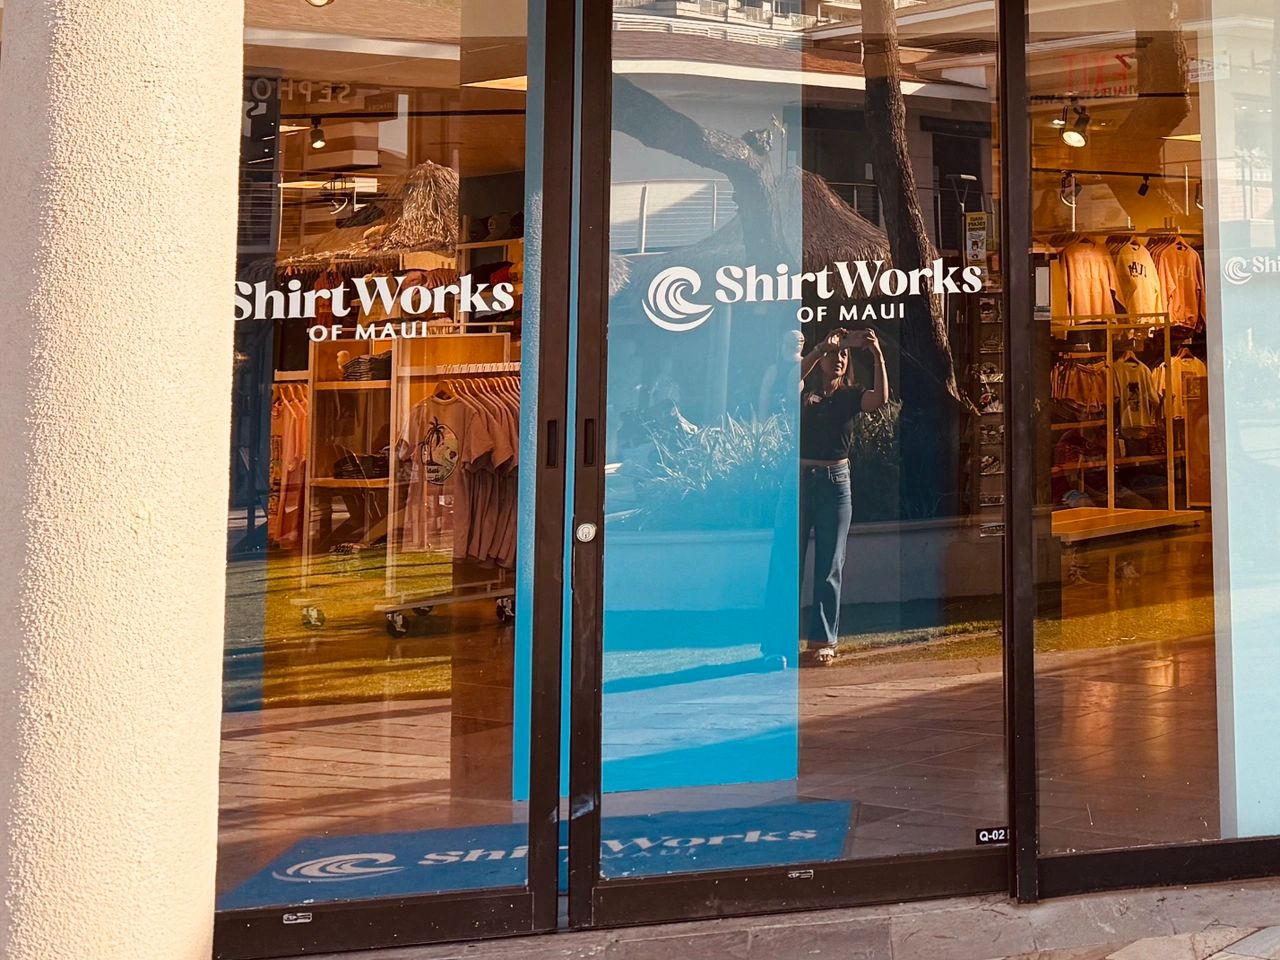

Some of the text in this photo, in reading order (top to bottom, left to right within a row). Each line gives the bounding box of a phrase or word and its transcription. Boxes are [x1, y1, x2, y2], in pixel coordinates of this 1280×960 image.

[235, 273, 514, 321] ShirtWorks
[715, 257, 983, 304] ShirtWorks
[796, 303, 905, 323] OF MAUI
[308, 321, 428, 342] OF MAUI
